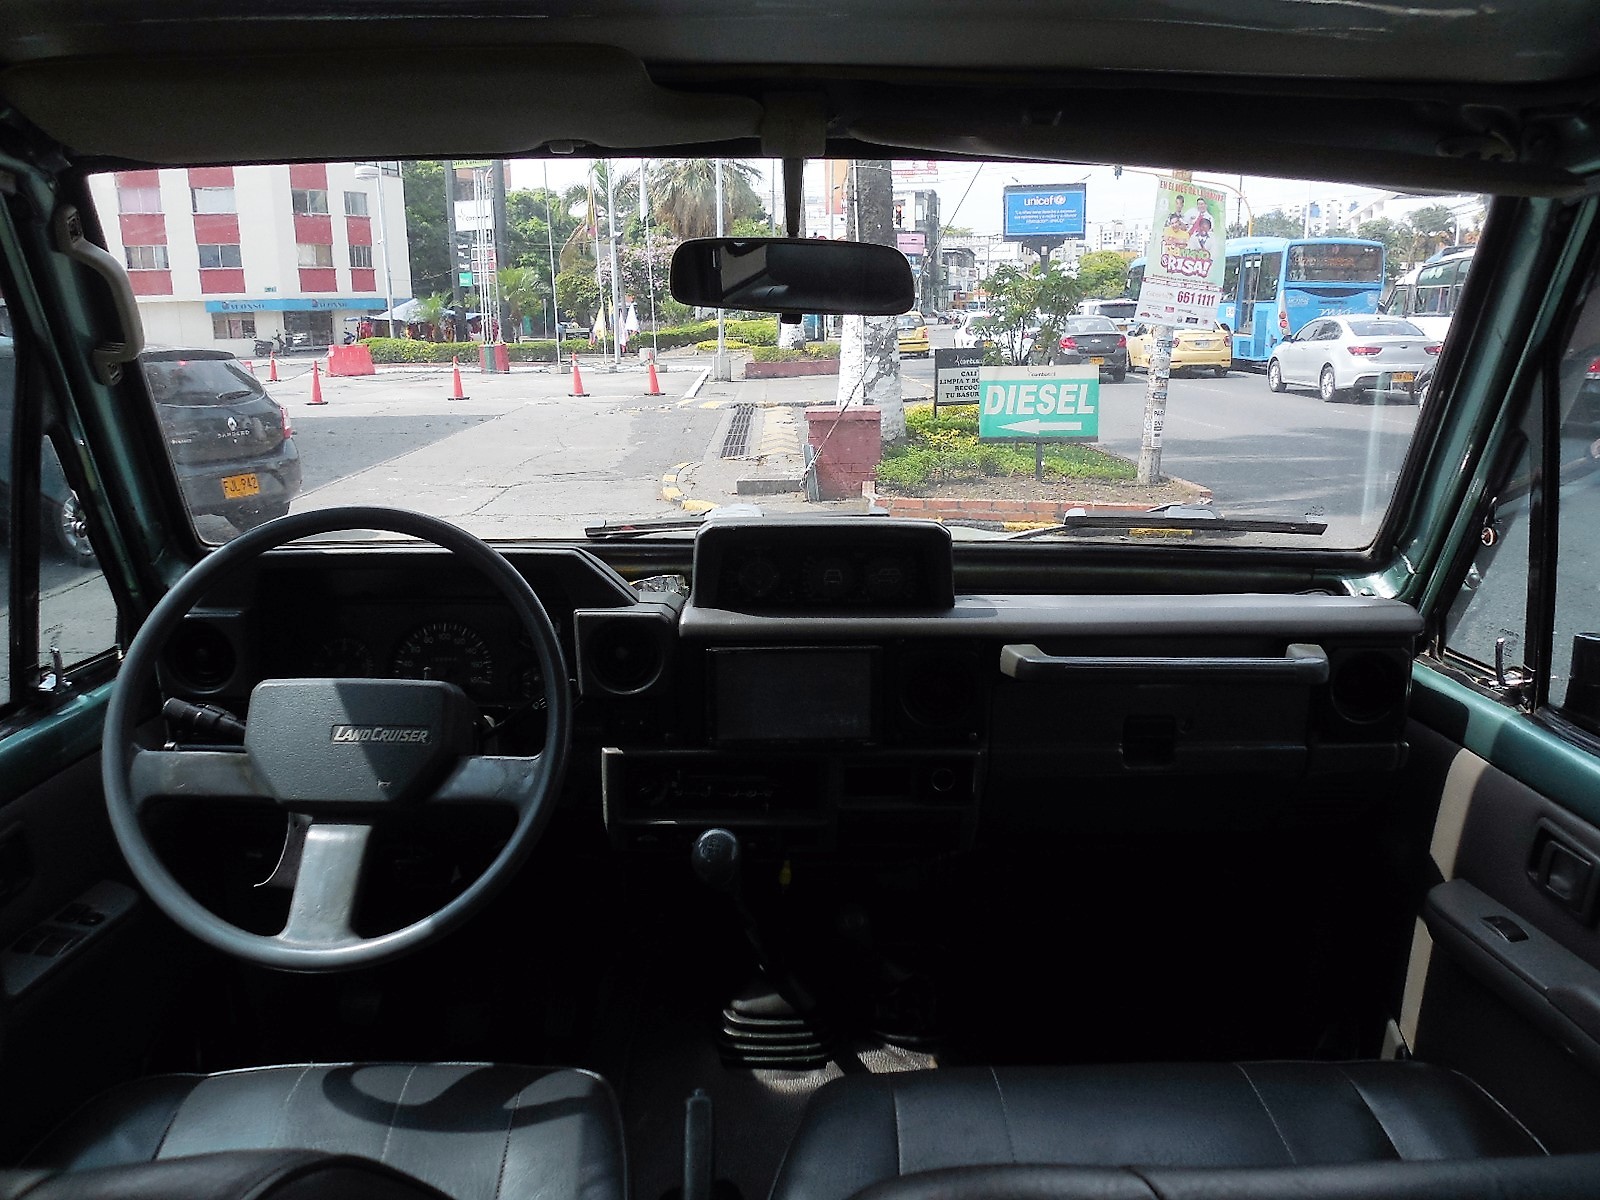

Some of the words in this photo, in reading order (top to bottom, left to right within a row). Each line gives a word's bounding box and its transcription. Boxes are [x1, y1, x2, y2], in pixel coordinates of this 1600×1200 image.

[1024, 194, 1054, 206] unicef
[1177, 290, 1196, 304] 661
[1197, 293, 1216, 307] 1111
[984, 383, 1095, 415] DIESEL
